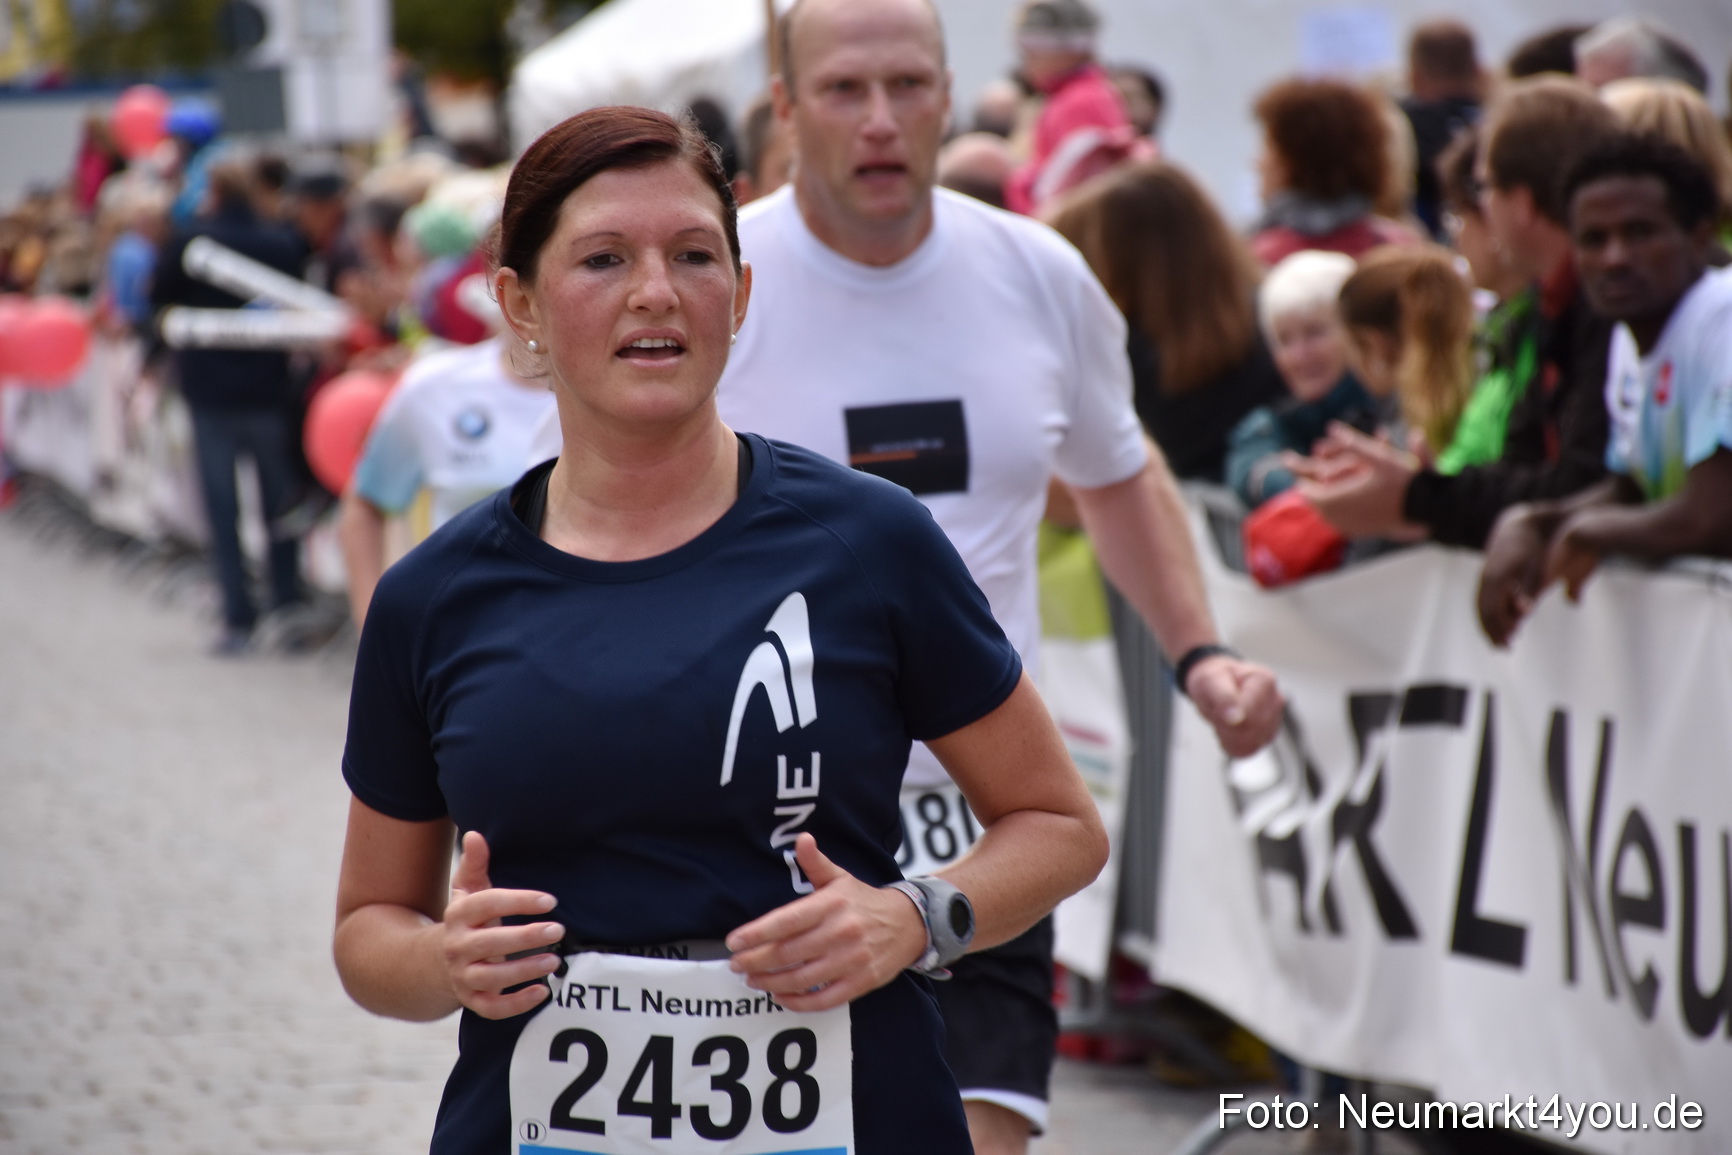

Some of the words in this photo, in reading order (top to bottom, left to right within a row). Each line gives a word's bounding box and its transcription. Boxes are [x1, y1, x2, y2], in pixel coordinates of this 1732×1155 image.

[641, 988, 784, 1019] Neumark
[548, 1027, 821, 1141] 2438
[527, 1122, 539, 1141] D
